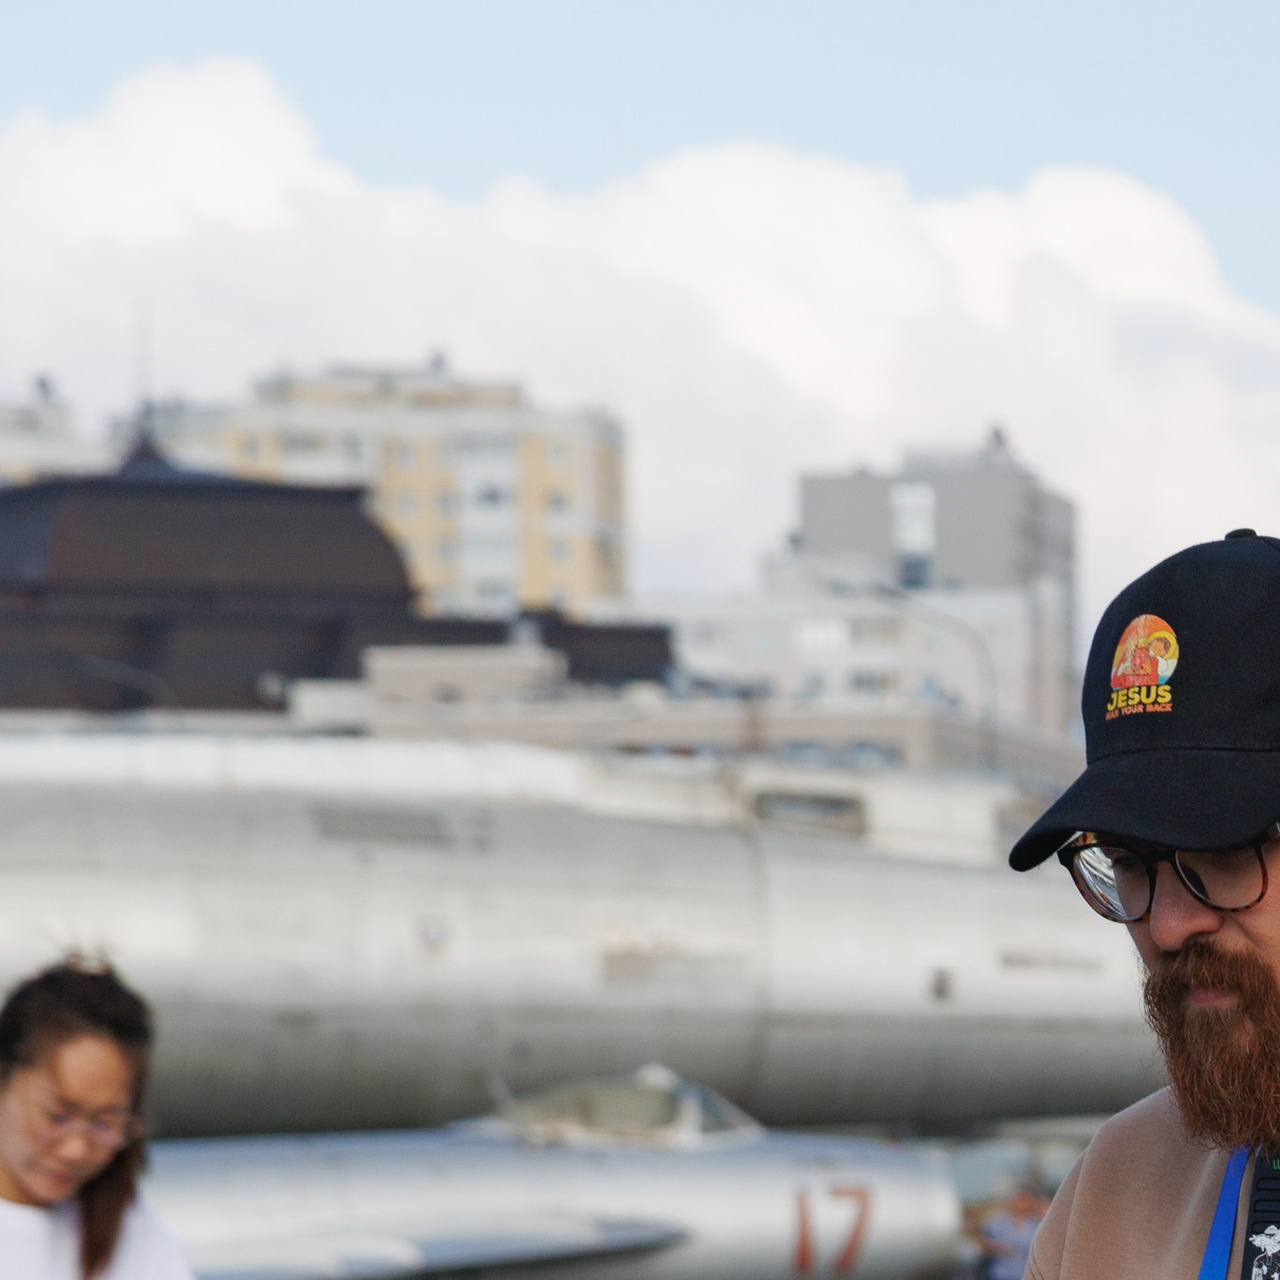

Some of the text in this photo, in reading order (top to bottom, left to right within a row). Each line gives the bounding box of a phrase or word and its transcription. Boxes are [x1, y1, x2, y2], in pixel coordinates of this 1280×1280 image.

[1107, 685, 1172, 711] JESUS
[1121, 704, 1144, 715] YOUR
[1146, 703, 1172, 712] BACK
[793, 1184, 871, 1274] 17
